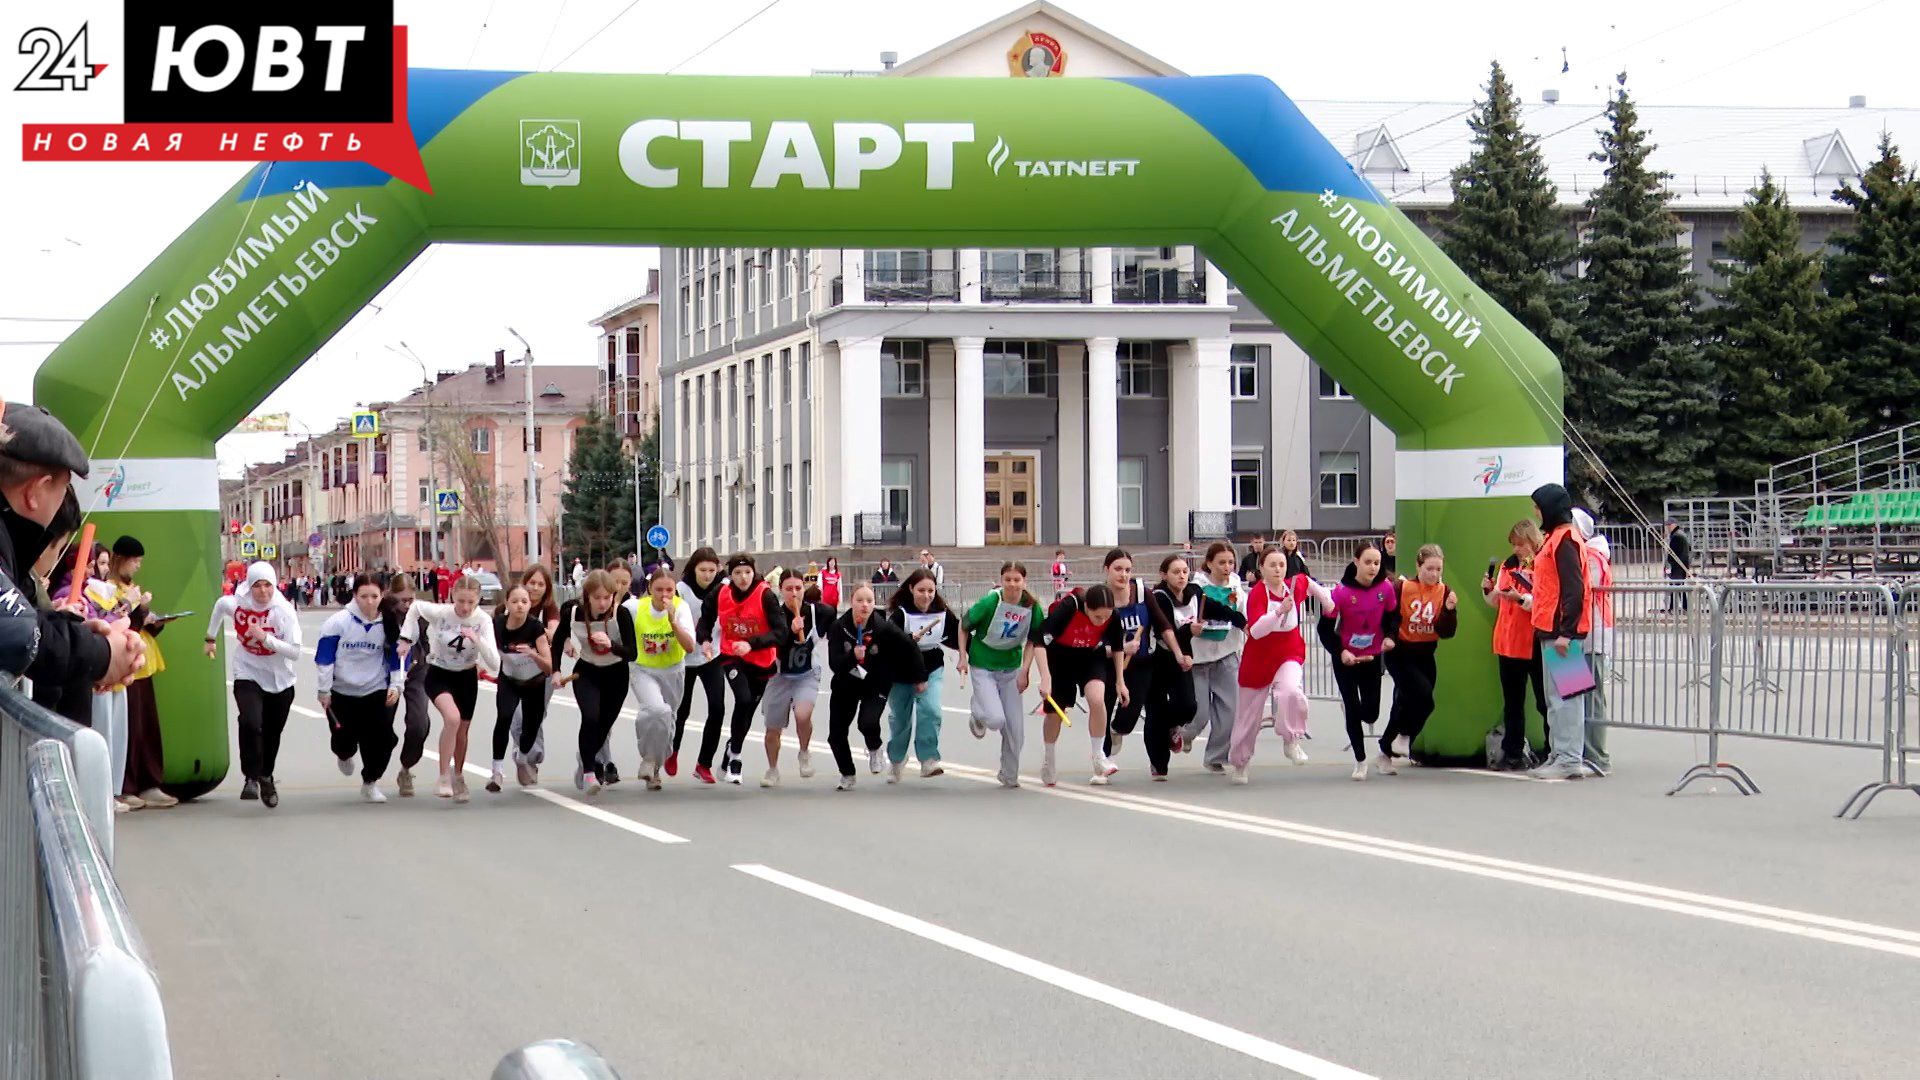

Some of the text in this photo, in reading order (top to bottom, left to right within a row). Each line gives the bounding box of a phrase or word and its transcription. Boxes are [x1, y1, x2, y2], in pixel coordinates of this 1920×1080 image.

[618, 119, 975, 190] СТАРТ
[1014, 160, 1140, 176] TATNEFT
[149, 179, 330, 350] #ЛЮБИМЫЙ
[171, 201, 378, 402] АЛЬМЕТЬЕВСК
[1270, 208, 1465, 395] АЛЬМЕТЬЕВСК
[1318, 188, 1482, 350] #ЛЮБИМЫЙ
[447, 631, 466, 653] 4
[1410, 600, 1434, 624] 24
